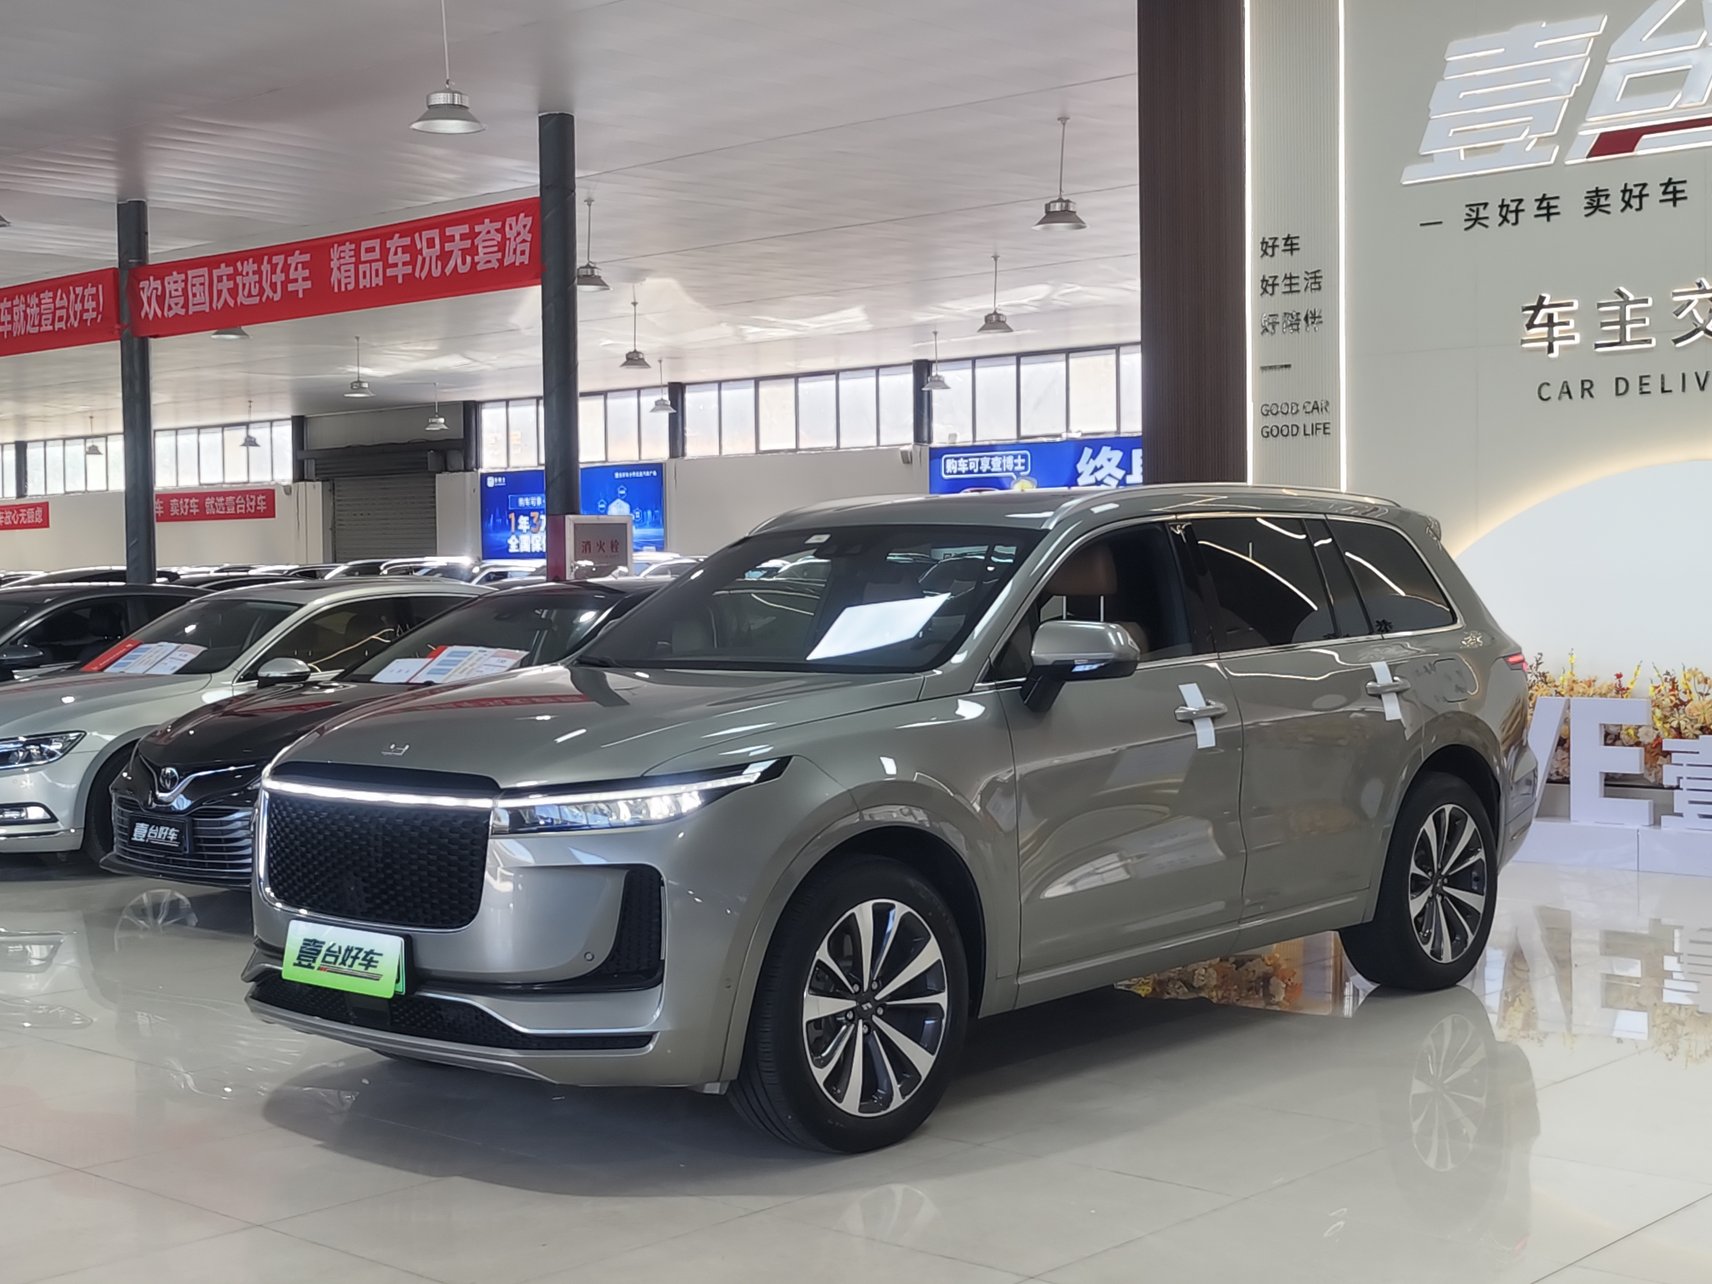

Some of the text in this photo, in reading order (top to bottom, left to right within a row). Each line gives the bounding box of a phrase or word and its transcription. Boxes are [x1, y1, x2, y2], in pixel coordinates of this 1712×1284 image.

[1463, 177, 1688, 231] 买好车 卖好车
[1260, 233, 1300, 258] 好车
[139, 213, 533, 320] 欢度国庆选好车 精品车况无套路
[1260, 269, 1323, 296] 好生活
[1260, 308, 1323, 336] 好陪伴
[1537, 378, 1595, 402] CAR
[1260, 400, 1330, 417] GOOD CAR
[1260, 422, 1331, 438] GOOD LIFE
[131, 822, 180, 842] 壹台好车
[292, 937, 384, 971] 壹台好车
